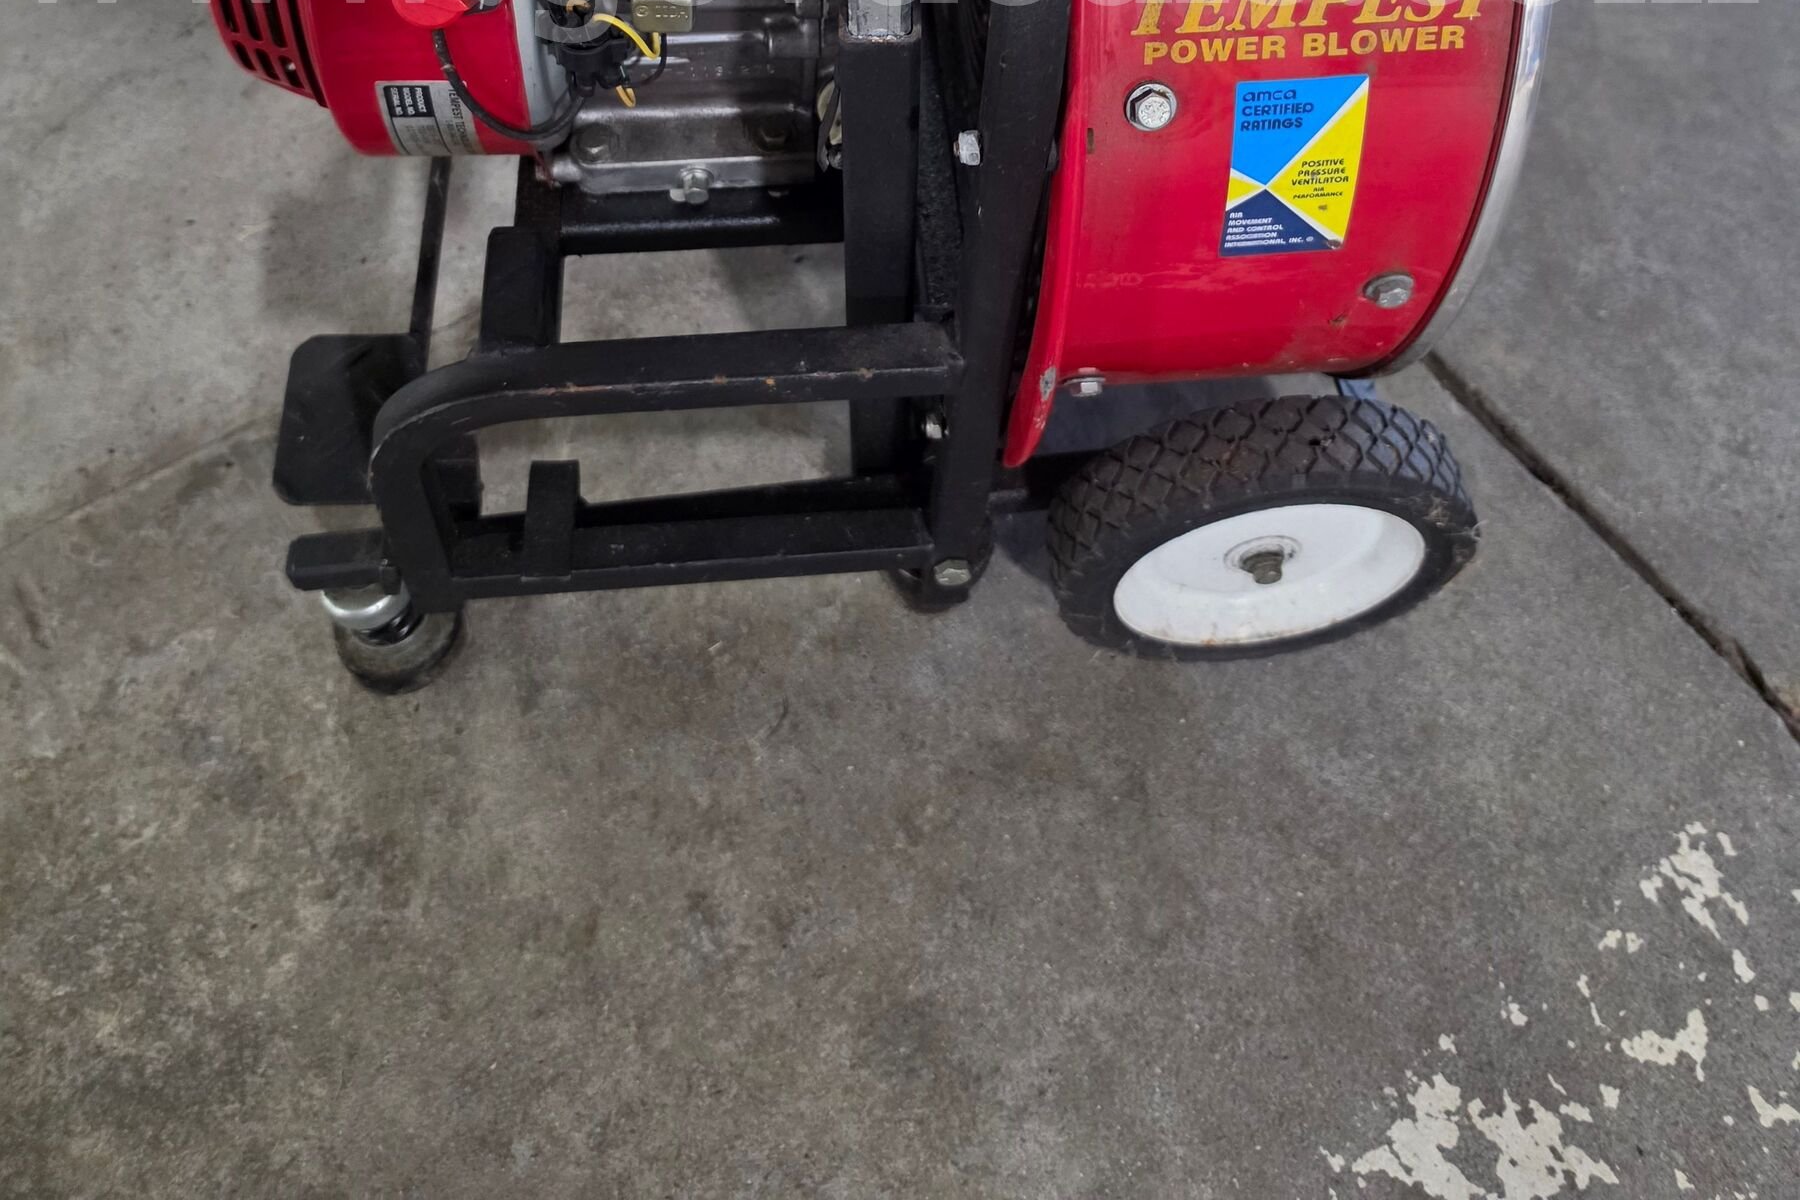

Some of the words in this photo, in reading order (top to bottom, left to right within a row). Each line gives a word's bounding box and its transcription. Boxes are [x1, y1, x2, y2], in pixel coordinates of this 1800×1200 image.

[1143, 34, 1287, 65] POWER
[1302, 24, 1465, 58] BLOWER
[1242, 102, 1314, 117] CERTIFIED
[1301, 158, 1345, 168] POSITIVE
[1297, 167, 1346, 177] PRESSURE
[1291, 176, 1349, 186] VENTILATOR
[1293, 191, 1343, 199] PERFORMANCE
[1228, 217, 1273, 226] MOVEMENT
[1246, 224, 1283, 232] CONTROL
